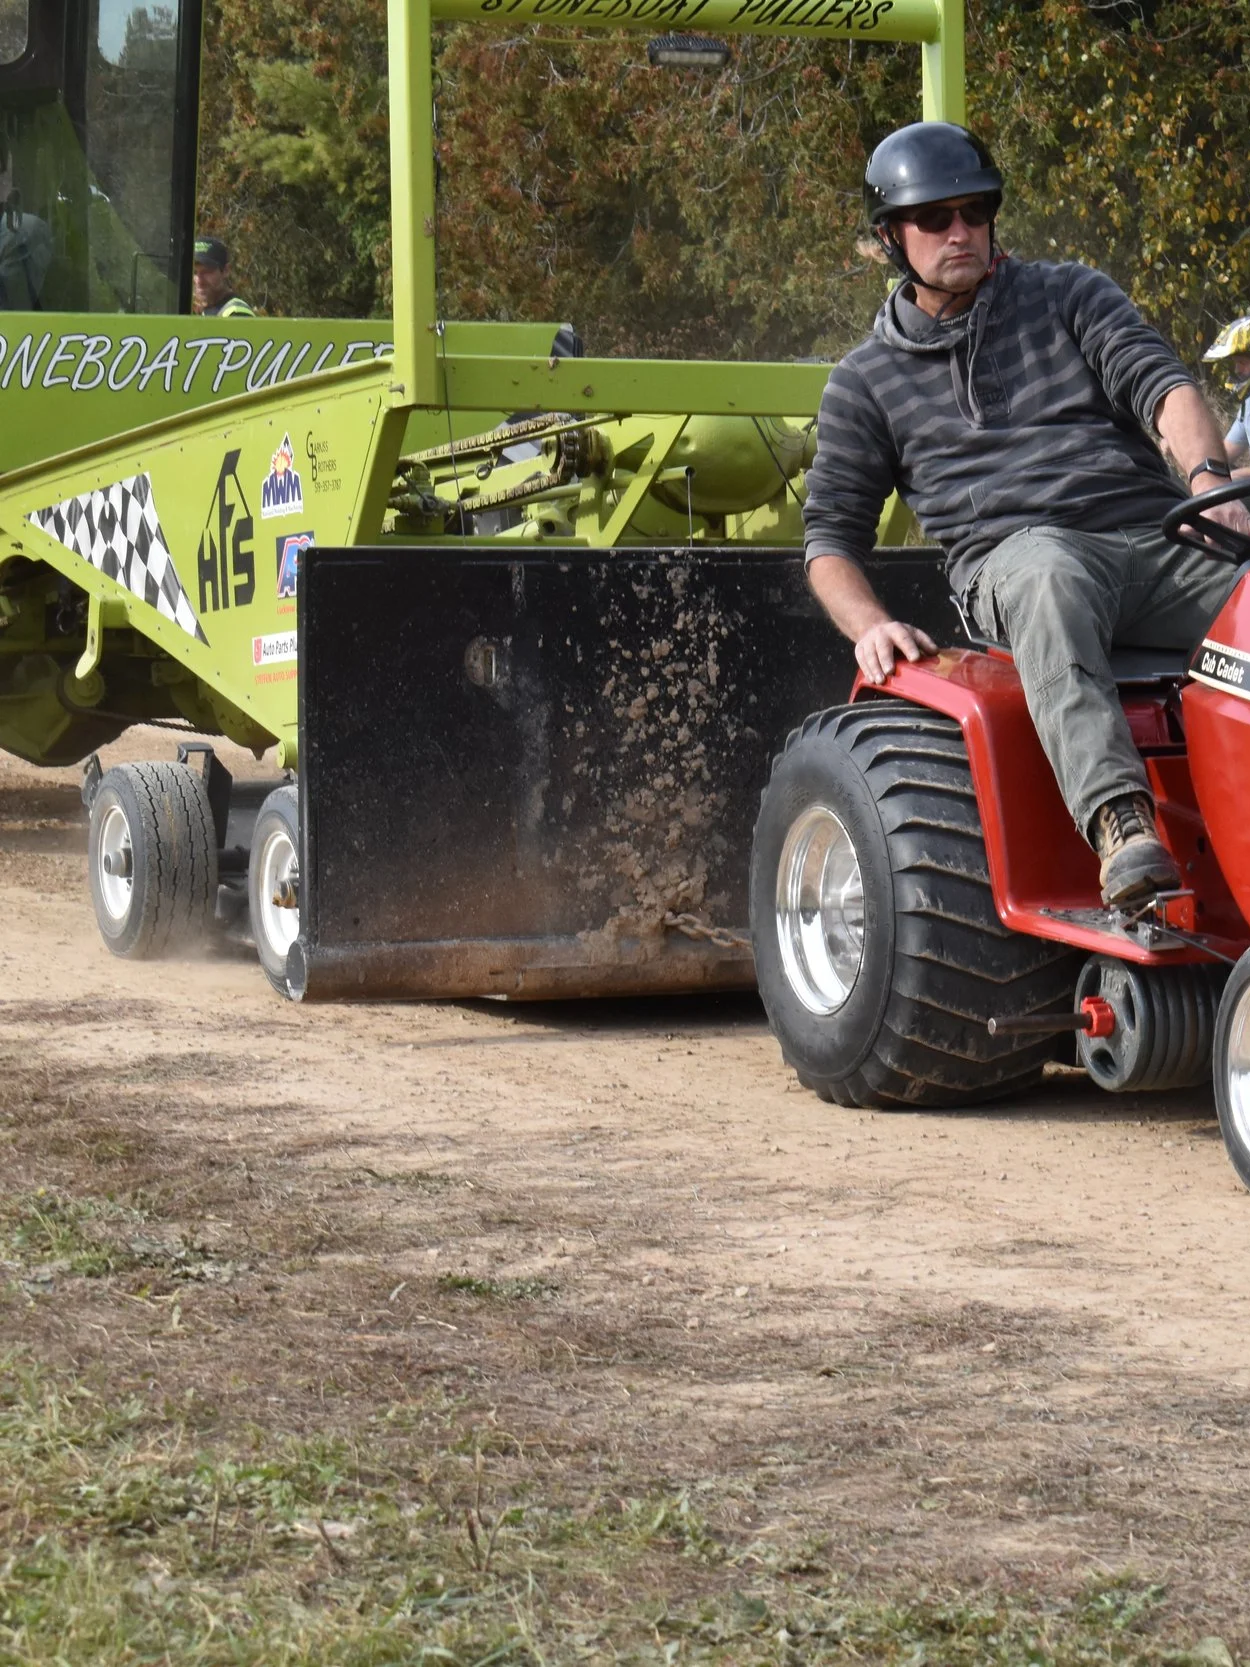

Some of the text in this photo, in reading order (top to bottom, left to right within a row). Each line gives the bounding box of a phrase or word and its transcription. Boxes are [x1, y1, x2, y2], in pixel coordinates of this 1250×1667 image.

[728, 0, 895, 30] PULLERS
[262, 467, 303, 509] MWM
[262, 641, 275, 657] Auto
[275, 639, 289, 655] Parts
[1202, 651, 1216, 674] Cub
[1217, 657, 1245, 683] Cadet
